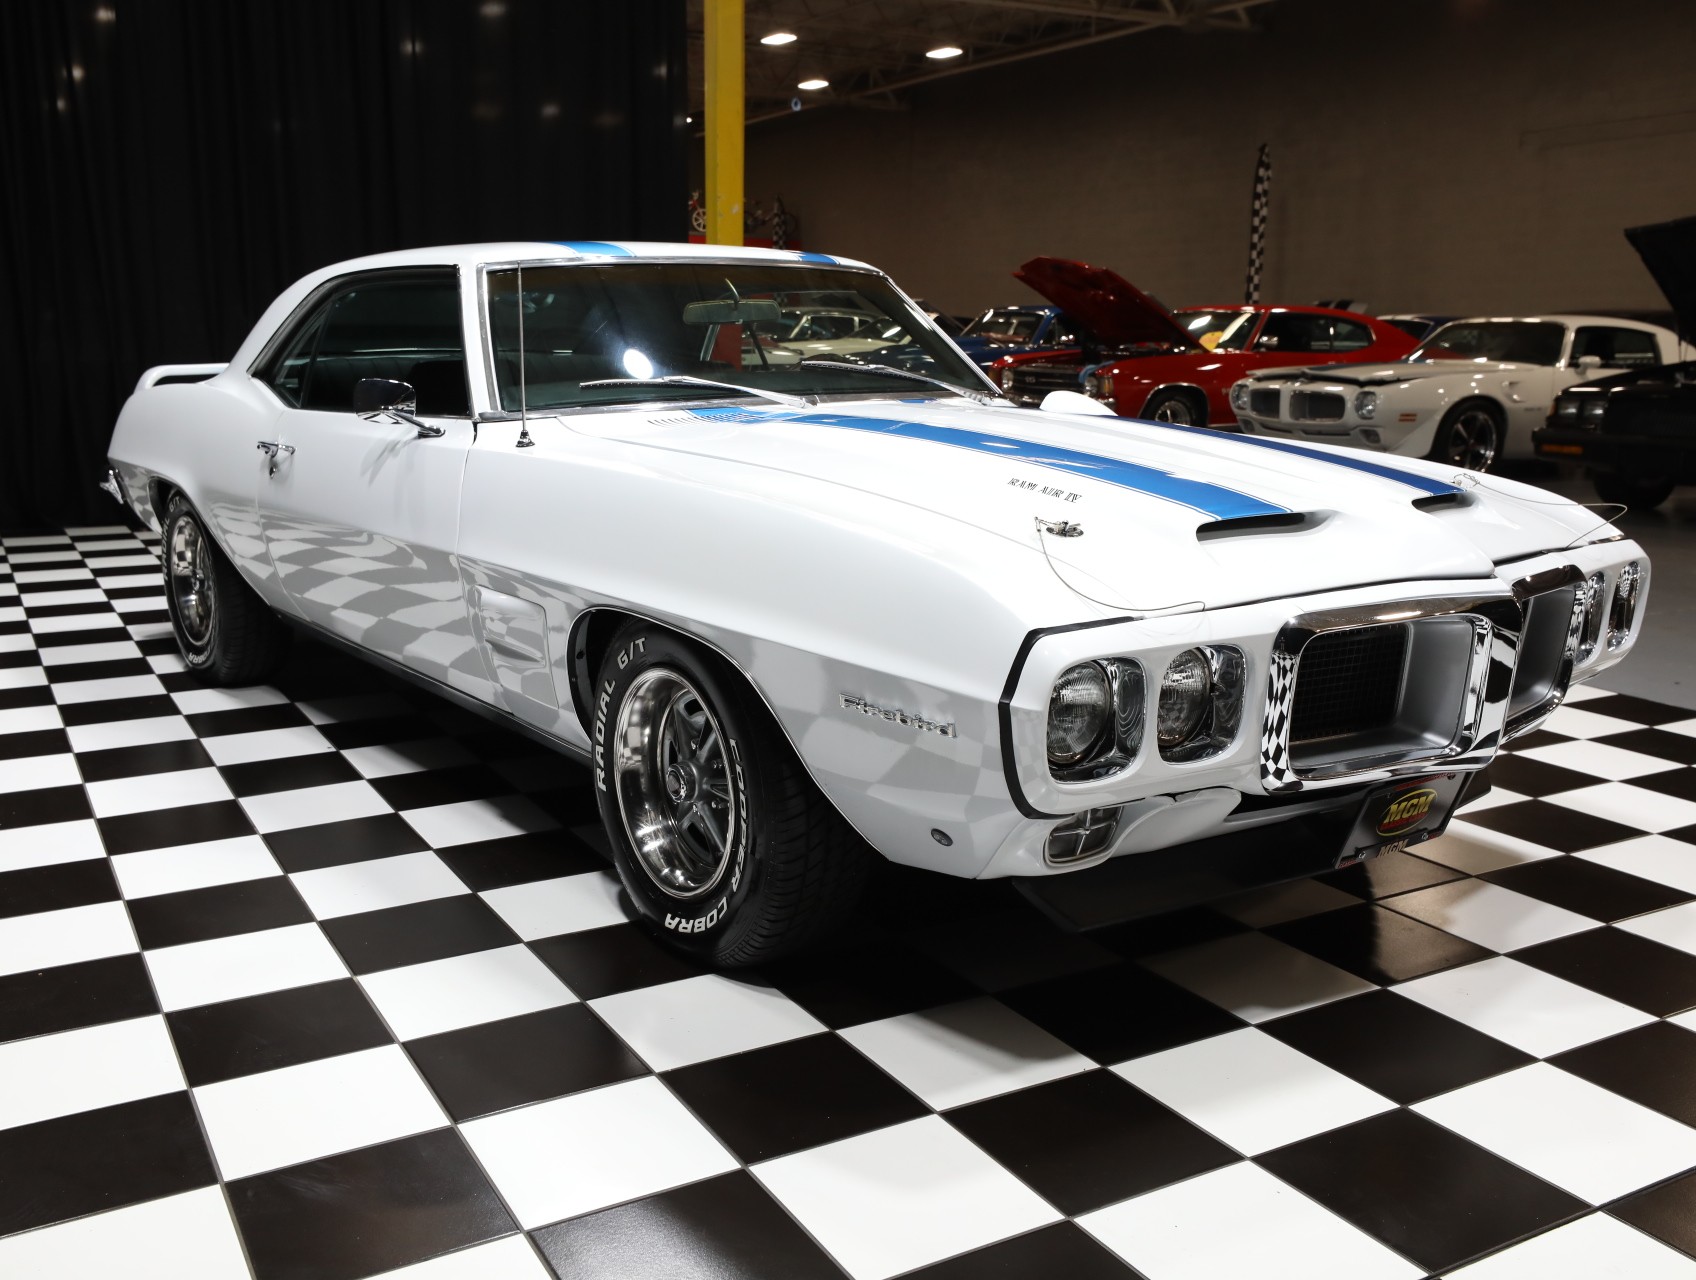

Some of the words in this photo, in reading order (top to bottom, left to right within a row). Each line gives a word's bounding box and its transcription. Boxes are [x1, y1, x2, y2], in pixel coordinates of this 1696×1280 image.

[1007, 477, 1038, 491] RAM
[1038, 485, 1065, 498] AIR
[1063, 492, 1083, 503] IV
[596, 679, 616, 792] RADIAL
[616, 637, 647, 670] G/T
[839, 692, 957, 738] Firebird
[729, 738, 748, 893] COOPER
[1383, 793, 1436, 824] MGM
[664, 897, 729, 934] COBRA
